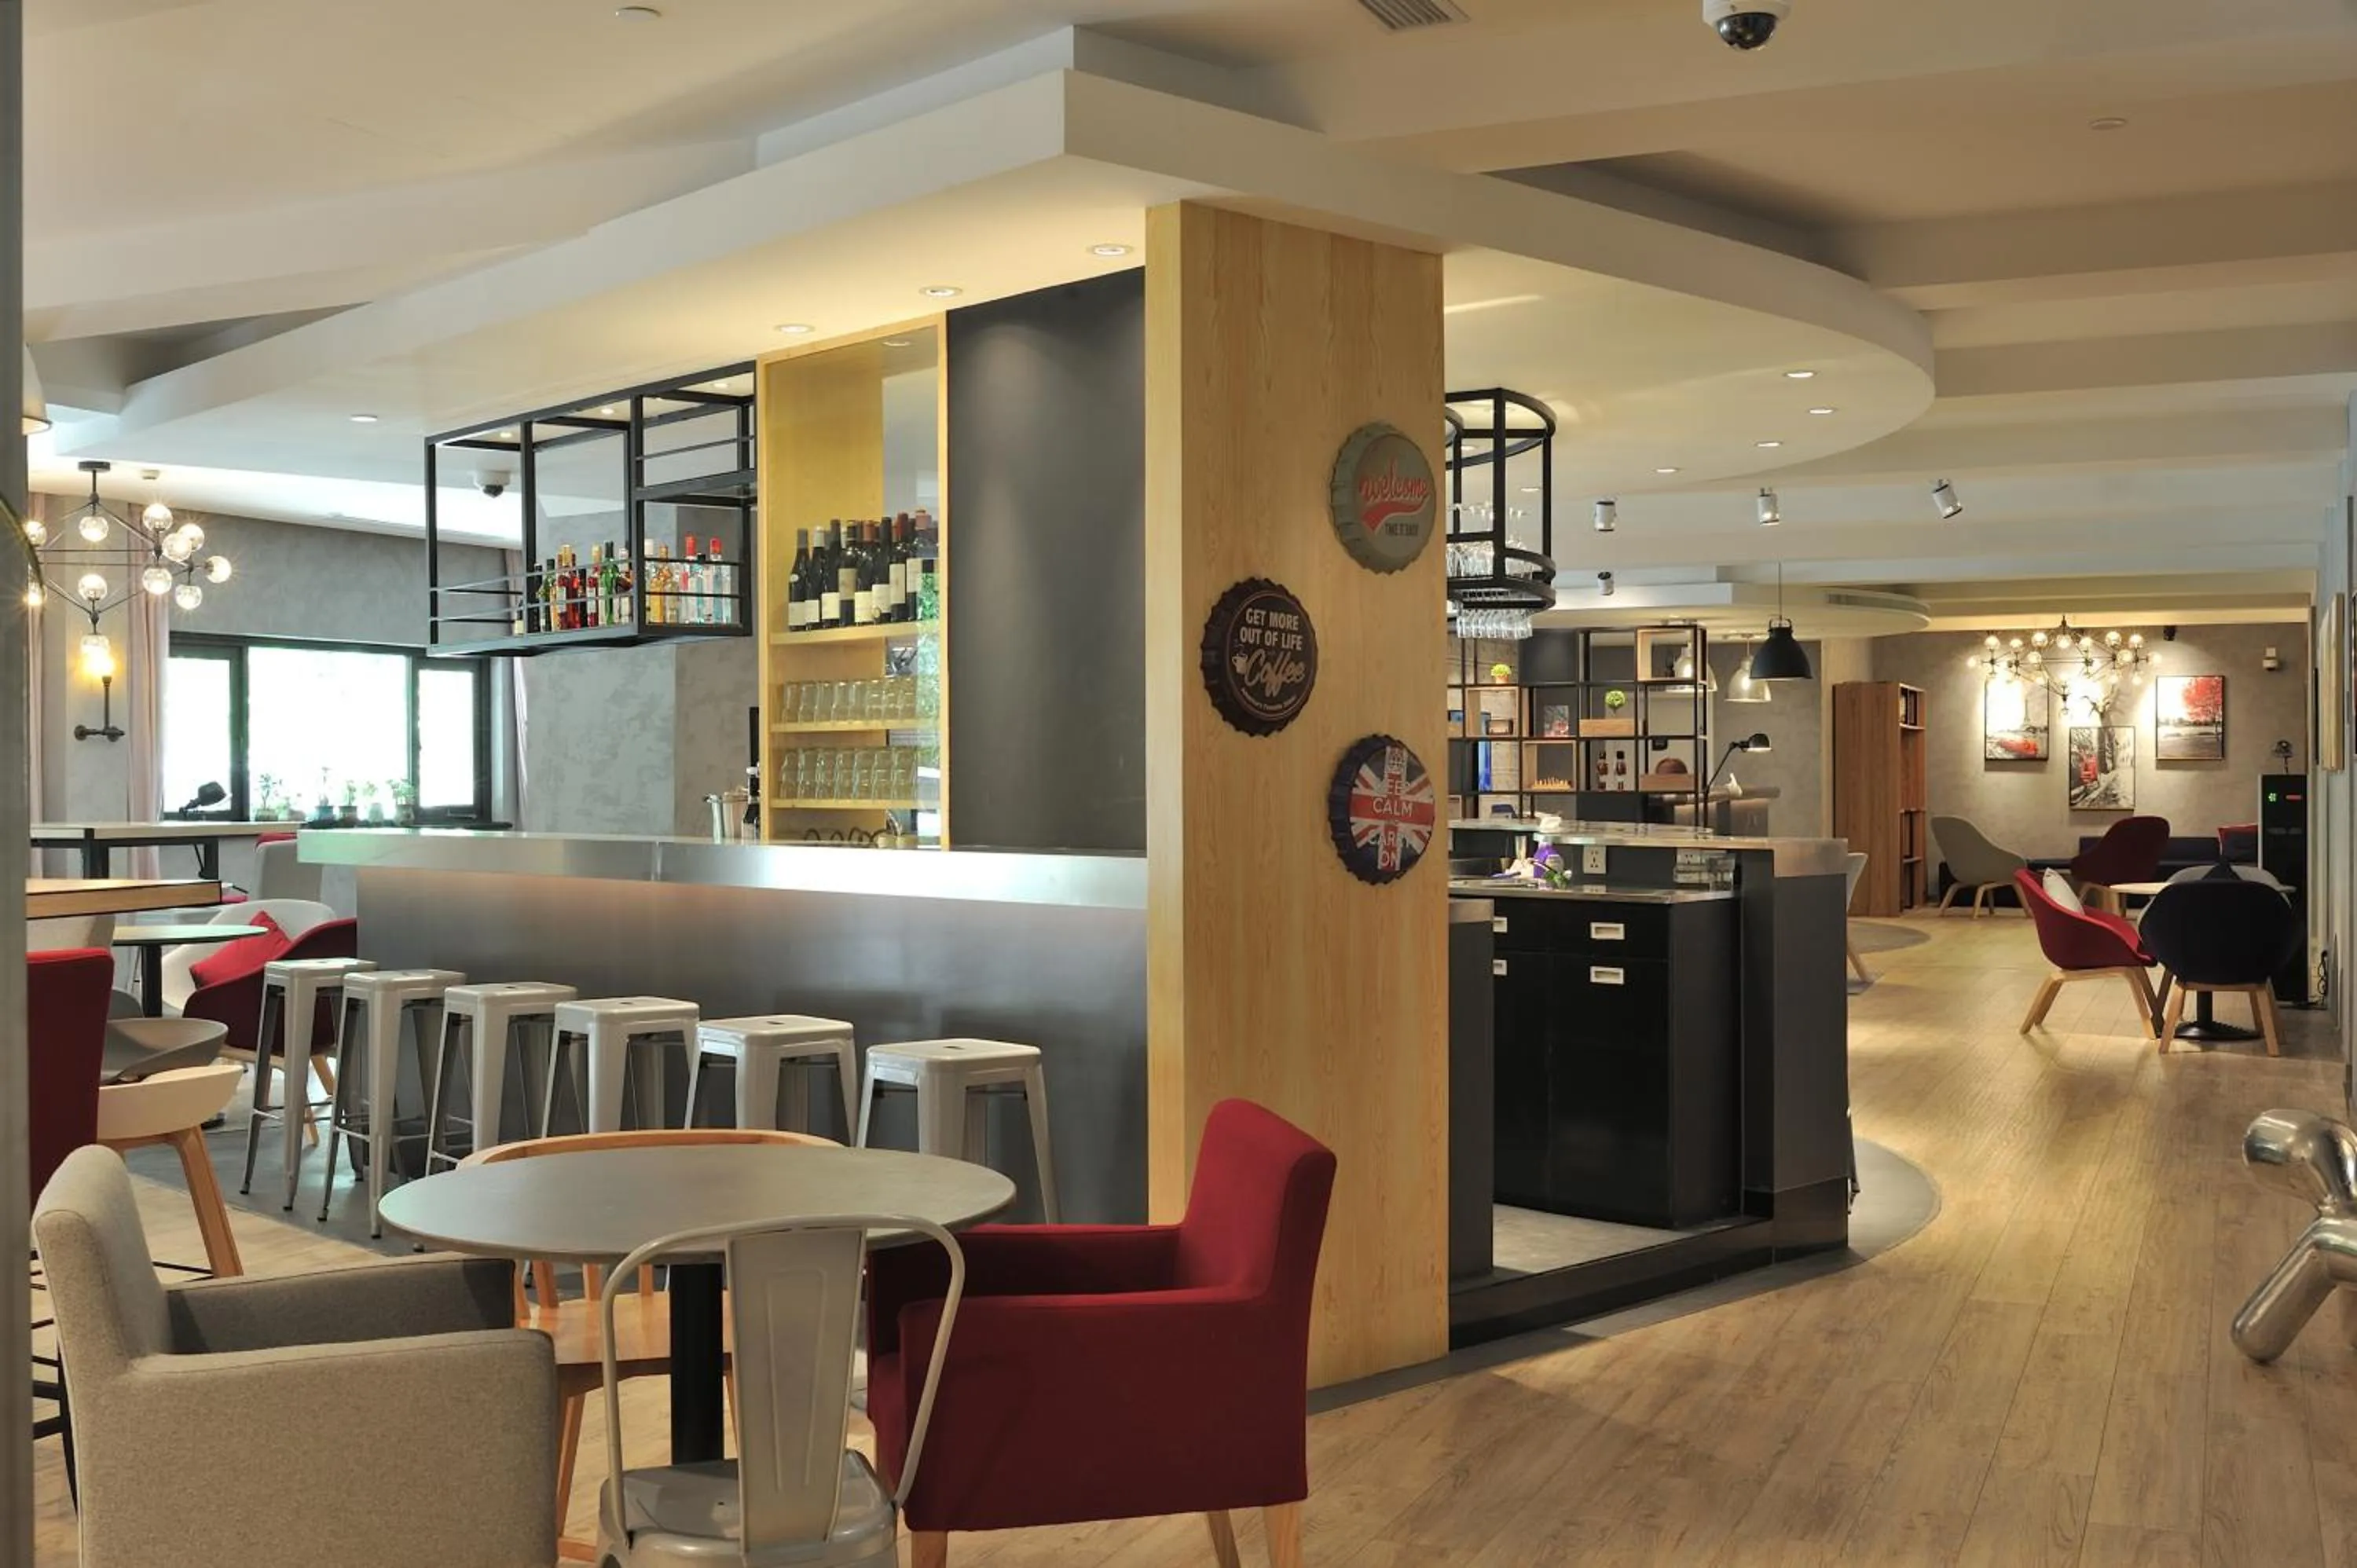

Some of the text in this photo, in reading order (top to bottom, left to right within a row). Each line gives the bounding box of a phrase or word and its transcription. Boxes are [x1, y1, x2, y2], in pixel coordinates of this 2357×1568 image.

[1245, 608, 1299, 630] GET MORE
[1240, 627, 1303, 650] OUT OF LIFE
[1244, 649, 1305, 697] Coffee
[1373, 798, 1413, 817] CALM
[1381, 851, 1398, 866] ON
